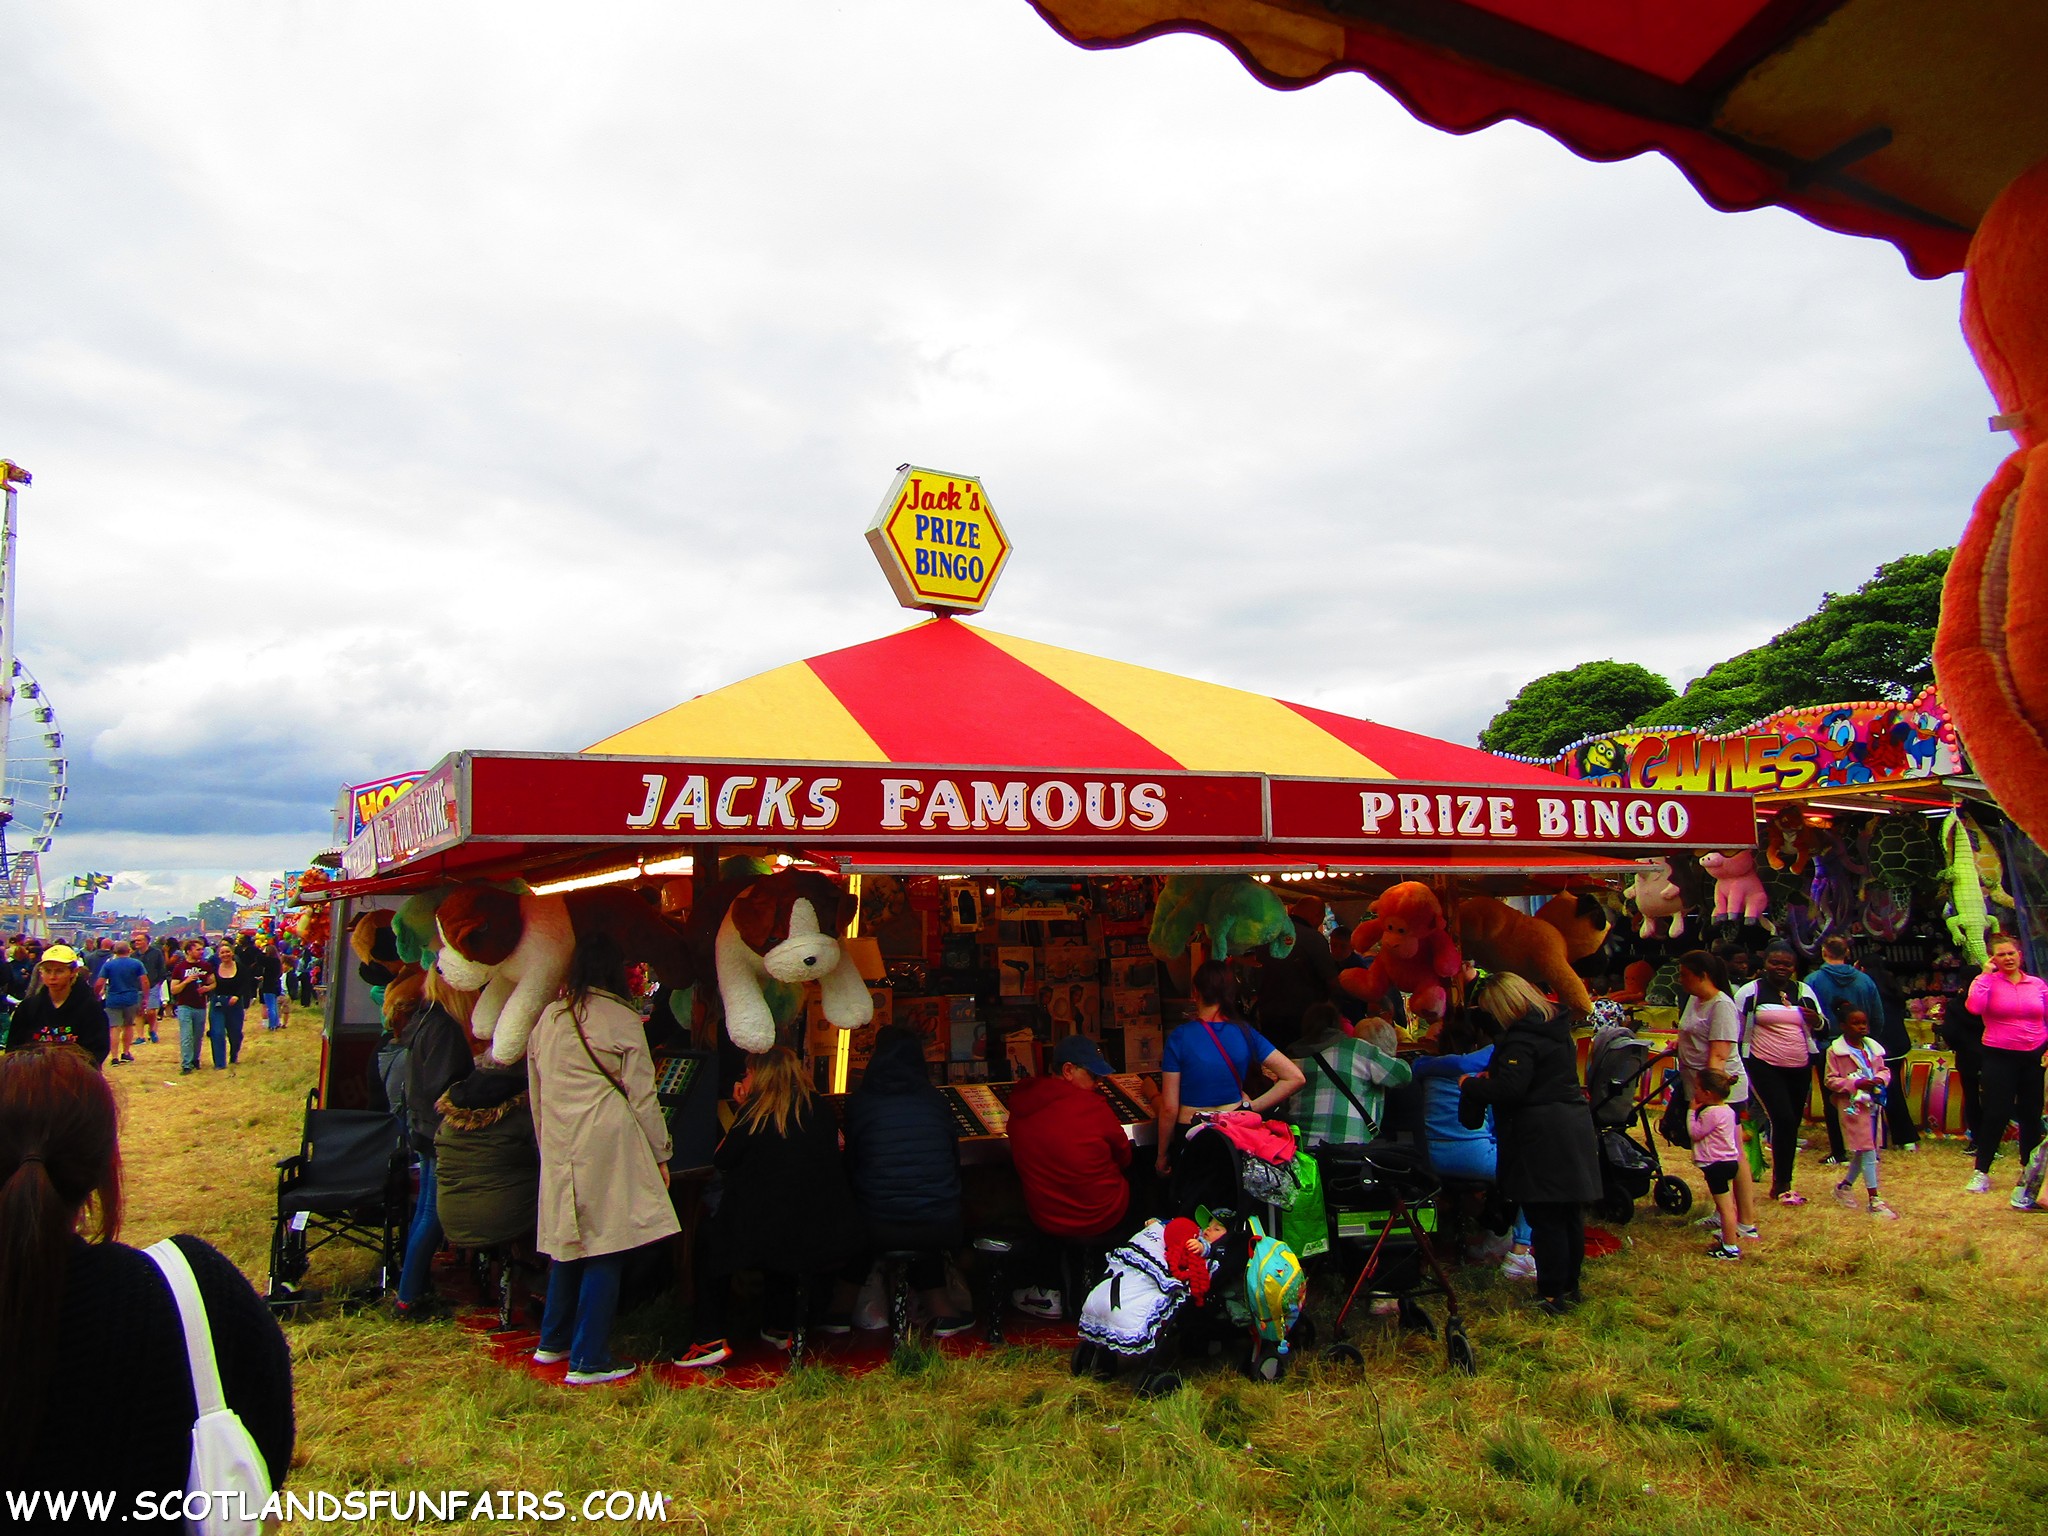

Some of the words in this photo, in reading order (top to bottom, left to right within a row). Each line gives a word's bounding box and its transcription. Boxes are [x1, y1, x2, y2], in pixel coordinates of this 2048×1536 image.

[907, 479, 981, 511] Jack's
[915, 514, 981, 550] PRIZE
[915, 548, 984, 583] BINGO
[1628, 734, 1819, 793] GAMES
[413, 777, 449, 843] LEISURE
[626, 774, 842, 830] JACKS
[880, 778, 1169, 831] FAMOUS
[1359, 791, 1518, 836] PRIZE
[1537, 798, 1690, 839] BINGO
